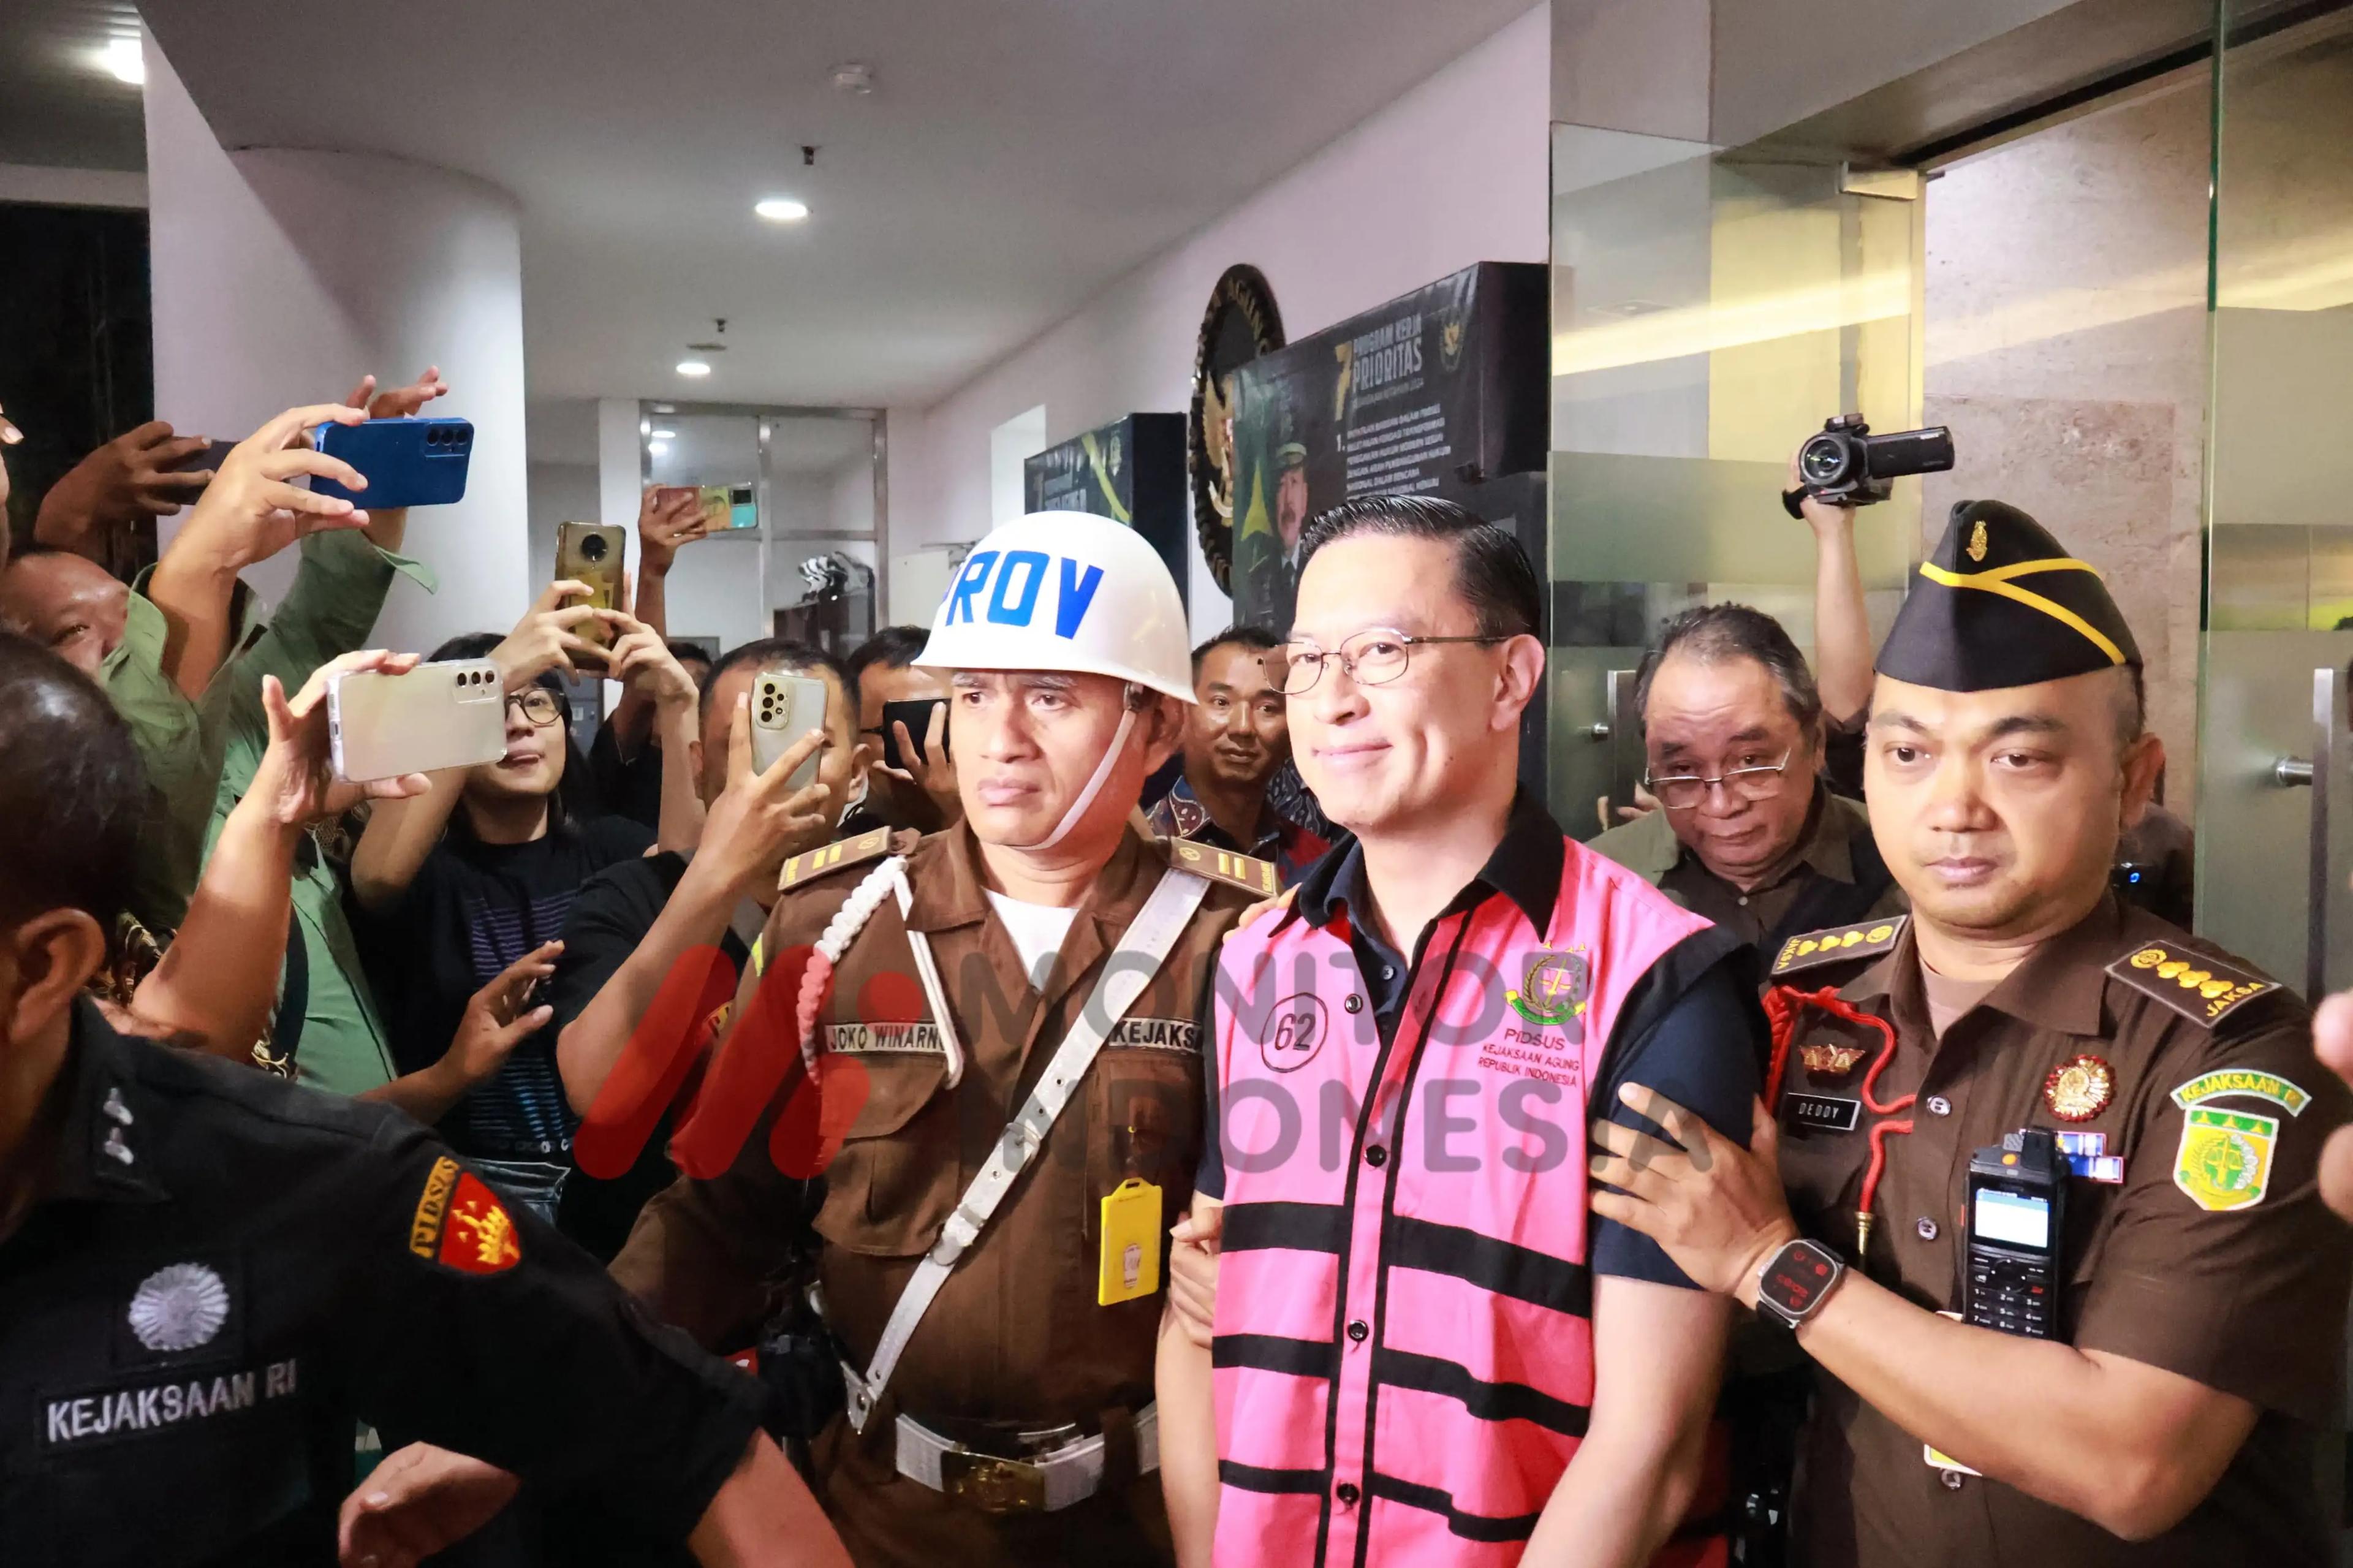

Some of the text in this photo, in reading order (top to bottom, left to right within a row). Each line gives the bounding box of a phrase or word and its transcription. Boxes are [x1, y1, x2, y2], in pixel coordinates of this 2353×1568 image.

[1335, 340, 1352, 421] 7
[1353, 337, 1422, 392] PRIORITAS
[942, 550, 1104, 640] ROV
[2207, 982, 2266, 1017] JAKSA
[830, 1026, 868, 1050] JOKO
[1275, 1013, 1315, 1051] 62
[1504, 1028, 1566, 1050] PIDSUS
[1478, 1057, 1577, 1088] REPUBLIK INDONESIA
[1483, 1044, 1579, 1071] KEJAKSAAN AGUNG
[2180, 1073, 2281, 1102] KEJAKSAAN
[1798, 1103, 1839, 1119] DEDDY
[48, 1358, 297, 1442] KEJAKSAAN RI
